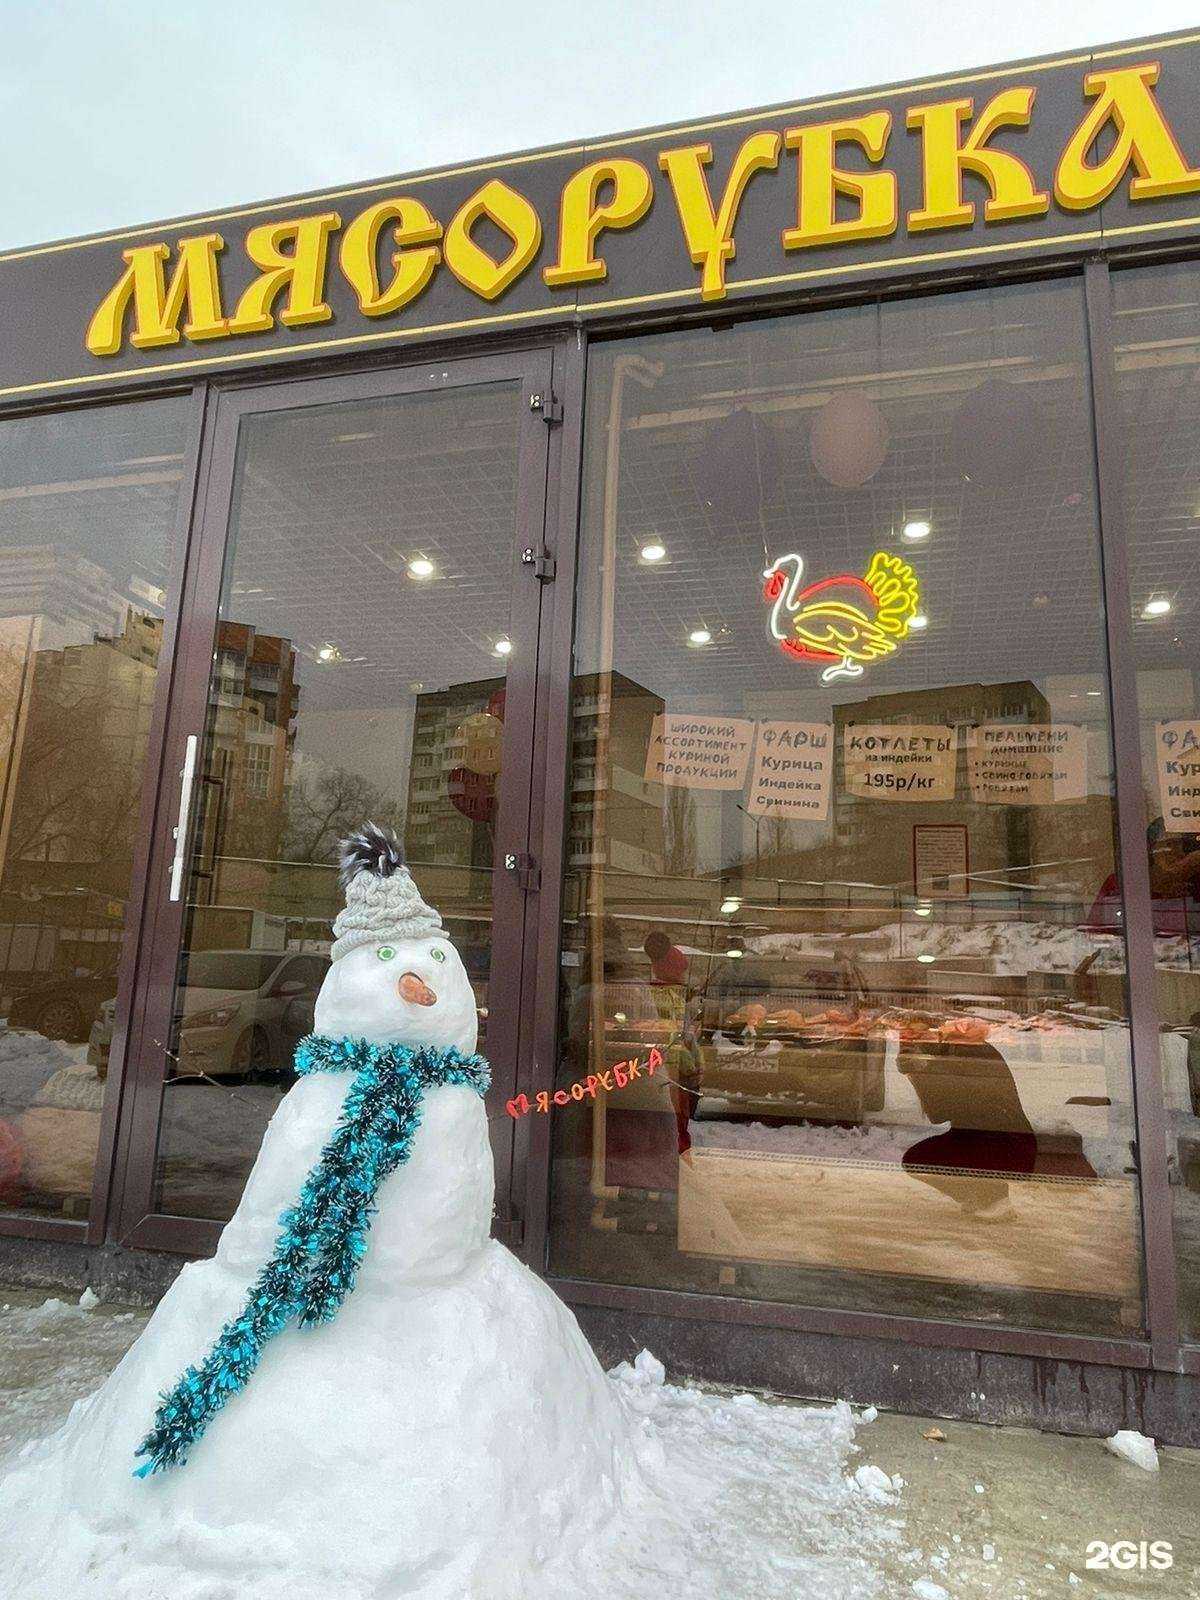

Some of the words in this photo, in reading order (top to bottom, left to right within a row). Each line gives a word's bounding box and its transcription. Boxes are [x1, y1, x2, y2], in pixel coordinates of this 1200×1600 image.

[86, 61, 1200, 356] МЯСОРУБКА
[671, 723, 735, 737] ШИРОКИЙ
[985, 731, 1068, 742] ПЕЛЬМЕНИ
[655, 735, 747, 751] АССОРТИМЕНТ
[763, 729, 827, 748] ФАРШ
[850, 736, 951, 751] КОТЛЕТЫ
[669, 750, 730, 764] КУРИНОЙ
[762, 756, 822, 771] Курица
[881, 753, 932, 764] индейки
[656, 762, 737, 778] ПРОДУКЦИИ
[759, 777, 821, 790] Индейка
[864, 772, 935, 791] 195р/кг
[505, 1048, 664, 1120] МЯСОРУБКА
